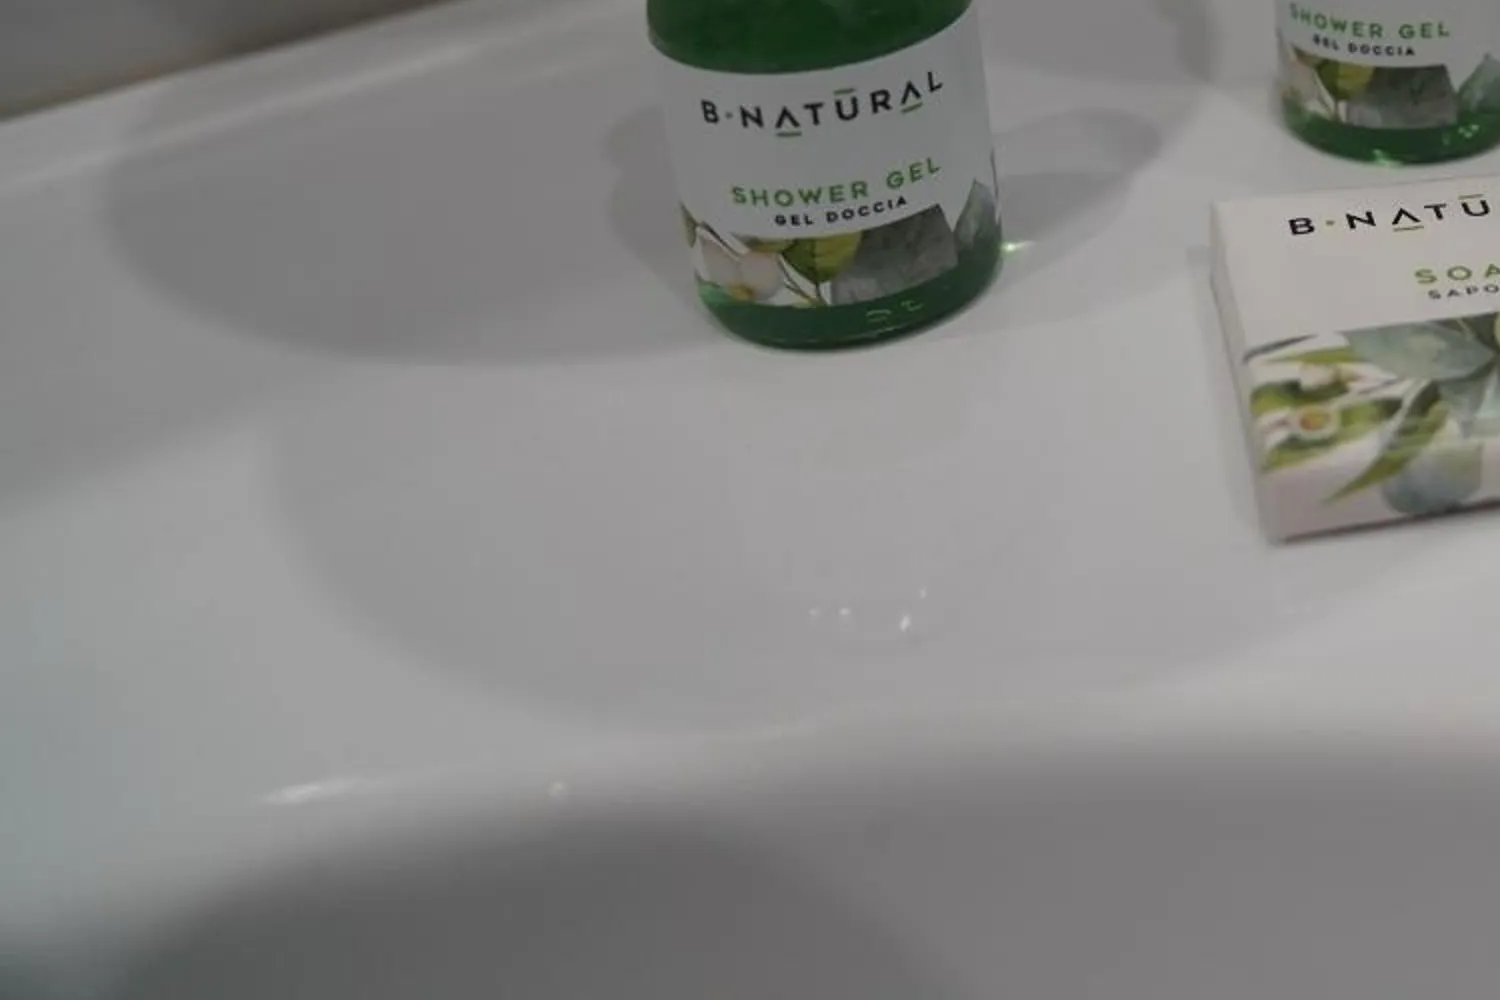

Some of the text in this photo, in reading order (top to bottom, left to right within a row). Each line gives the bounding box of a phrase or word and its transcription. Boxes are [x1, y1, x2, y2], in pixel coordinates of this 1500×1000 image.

[1289, 3, 1450, 39] SHOWER GEL
[1313, 34, 1416, 57] GEL DOCCIA
[731, 157, 941, 208] SHOWER GEL
[774, 196, 909, 227] GEL DOCCIA
